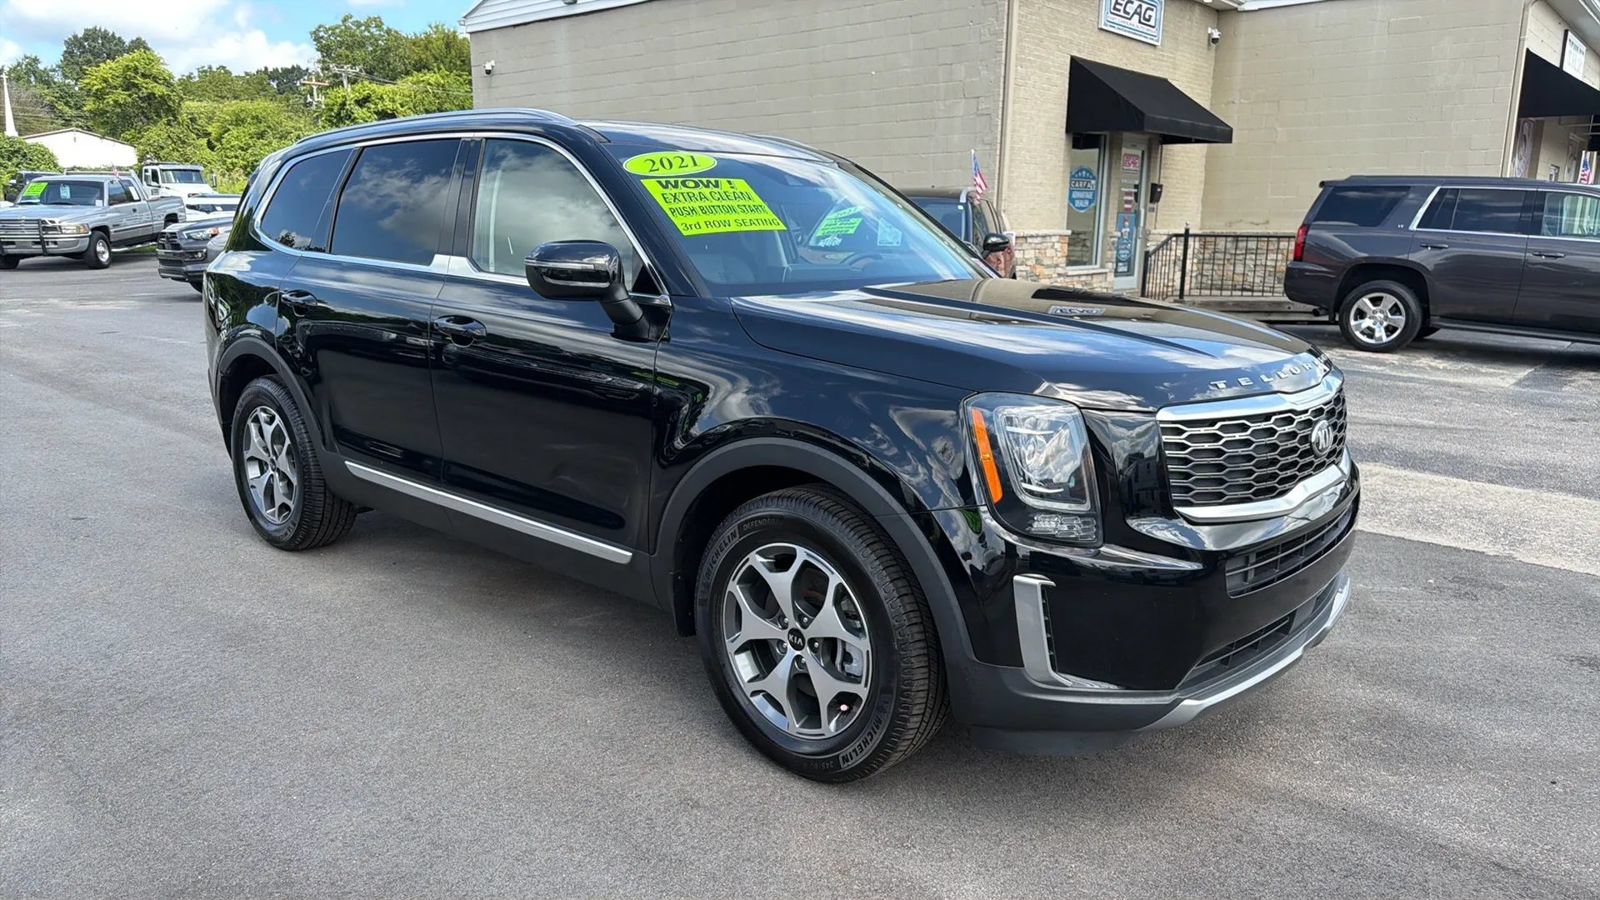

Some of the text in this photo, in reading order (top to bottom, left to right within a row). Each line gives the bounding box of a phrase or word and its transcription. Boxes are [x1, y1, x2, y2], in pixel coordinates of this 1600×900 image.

[1112, 0, 1155, 23] ECAG
[644, 154, 699, 172] 2021
[656, 179, 720, 189] WOW
[661, 190, 751, 204] EXTRA CLEAN
[670, 204, 767, 218] PUSH BUTTON START
[681, 218, 781, 231] 3rd ROW SEATING
[704, 529, 738, 580] MICHELIN
[788, 634, 804, 646] KIA
[841, 715, 882, 765] MICHELIN
